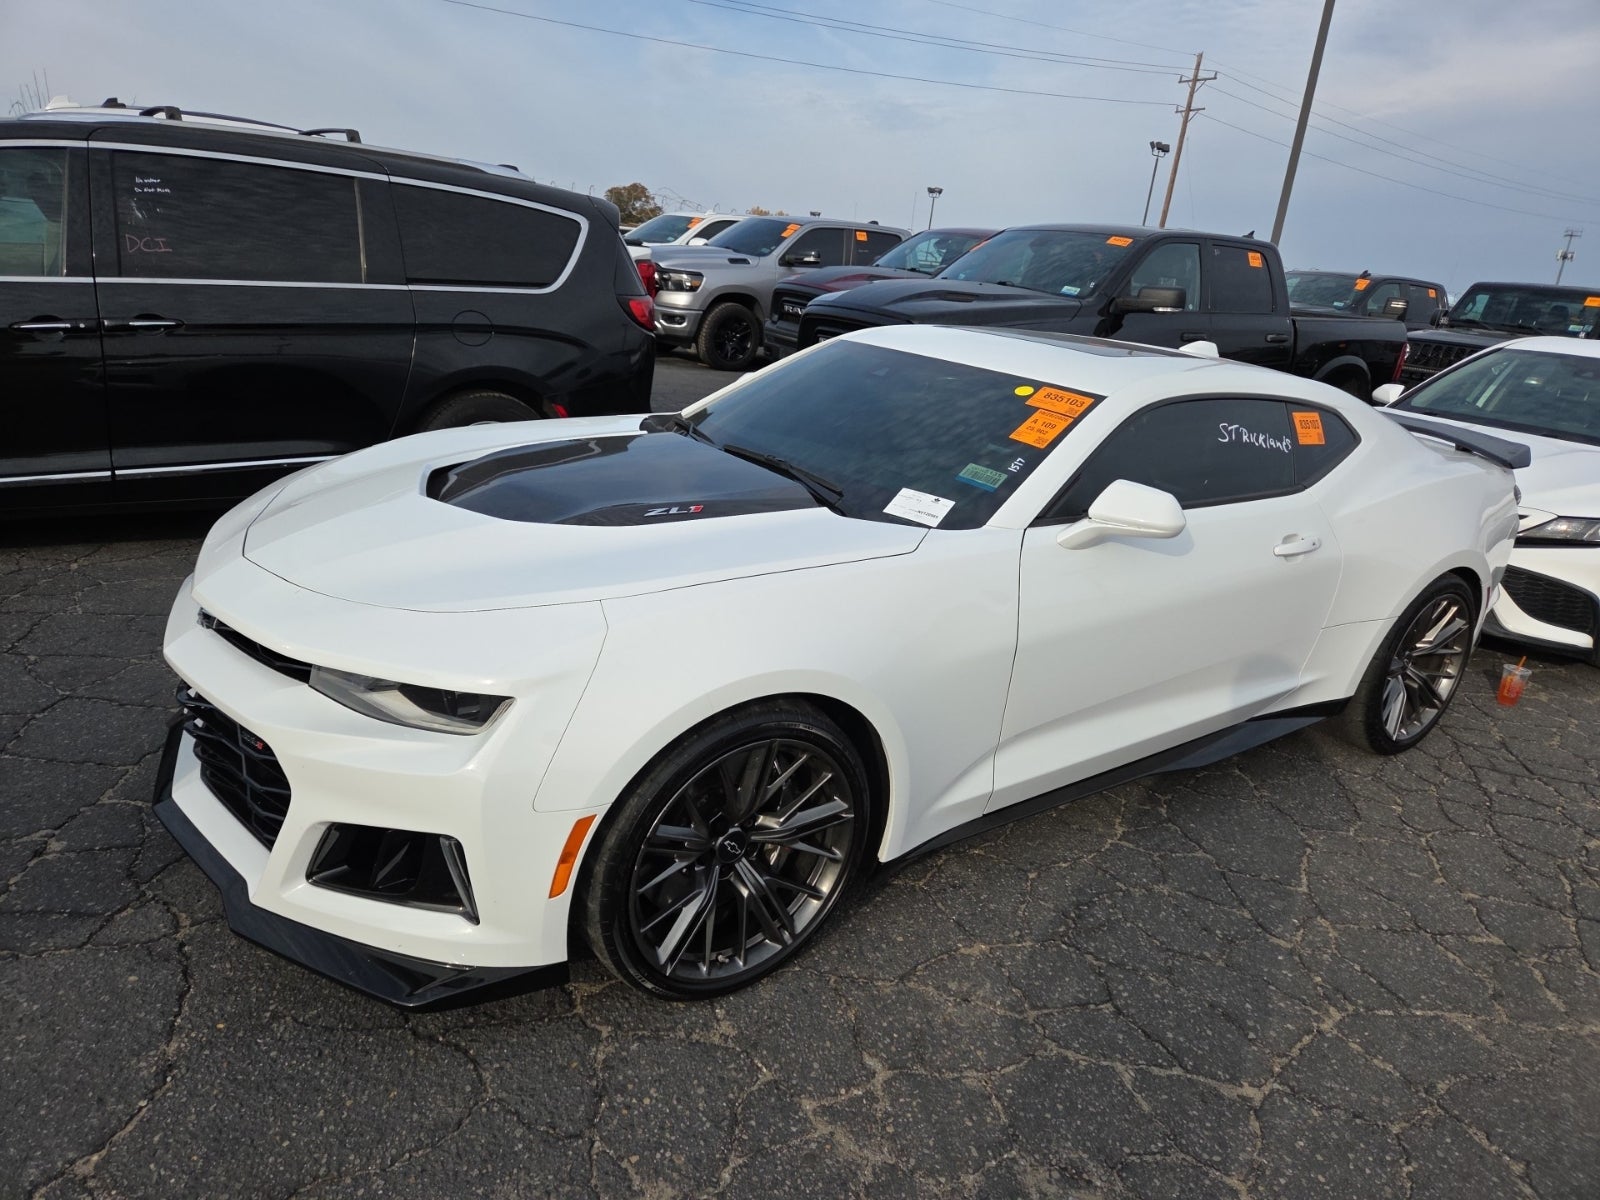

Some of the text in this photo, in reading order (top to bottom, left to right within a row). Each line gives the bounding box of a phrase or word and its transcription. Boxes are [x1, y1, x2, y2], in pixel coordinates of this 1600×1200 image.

[125, 233, 173, 253] DCI
[1043, 392, 1086, 408] 835103
[1041, 421, 1057, 430] 109
[643, 504, 704, 517] ZL1
